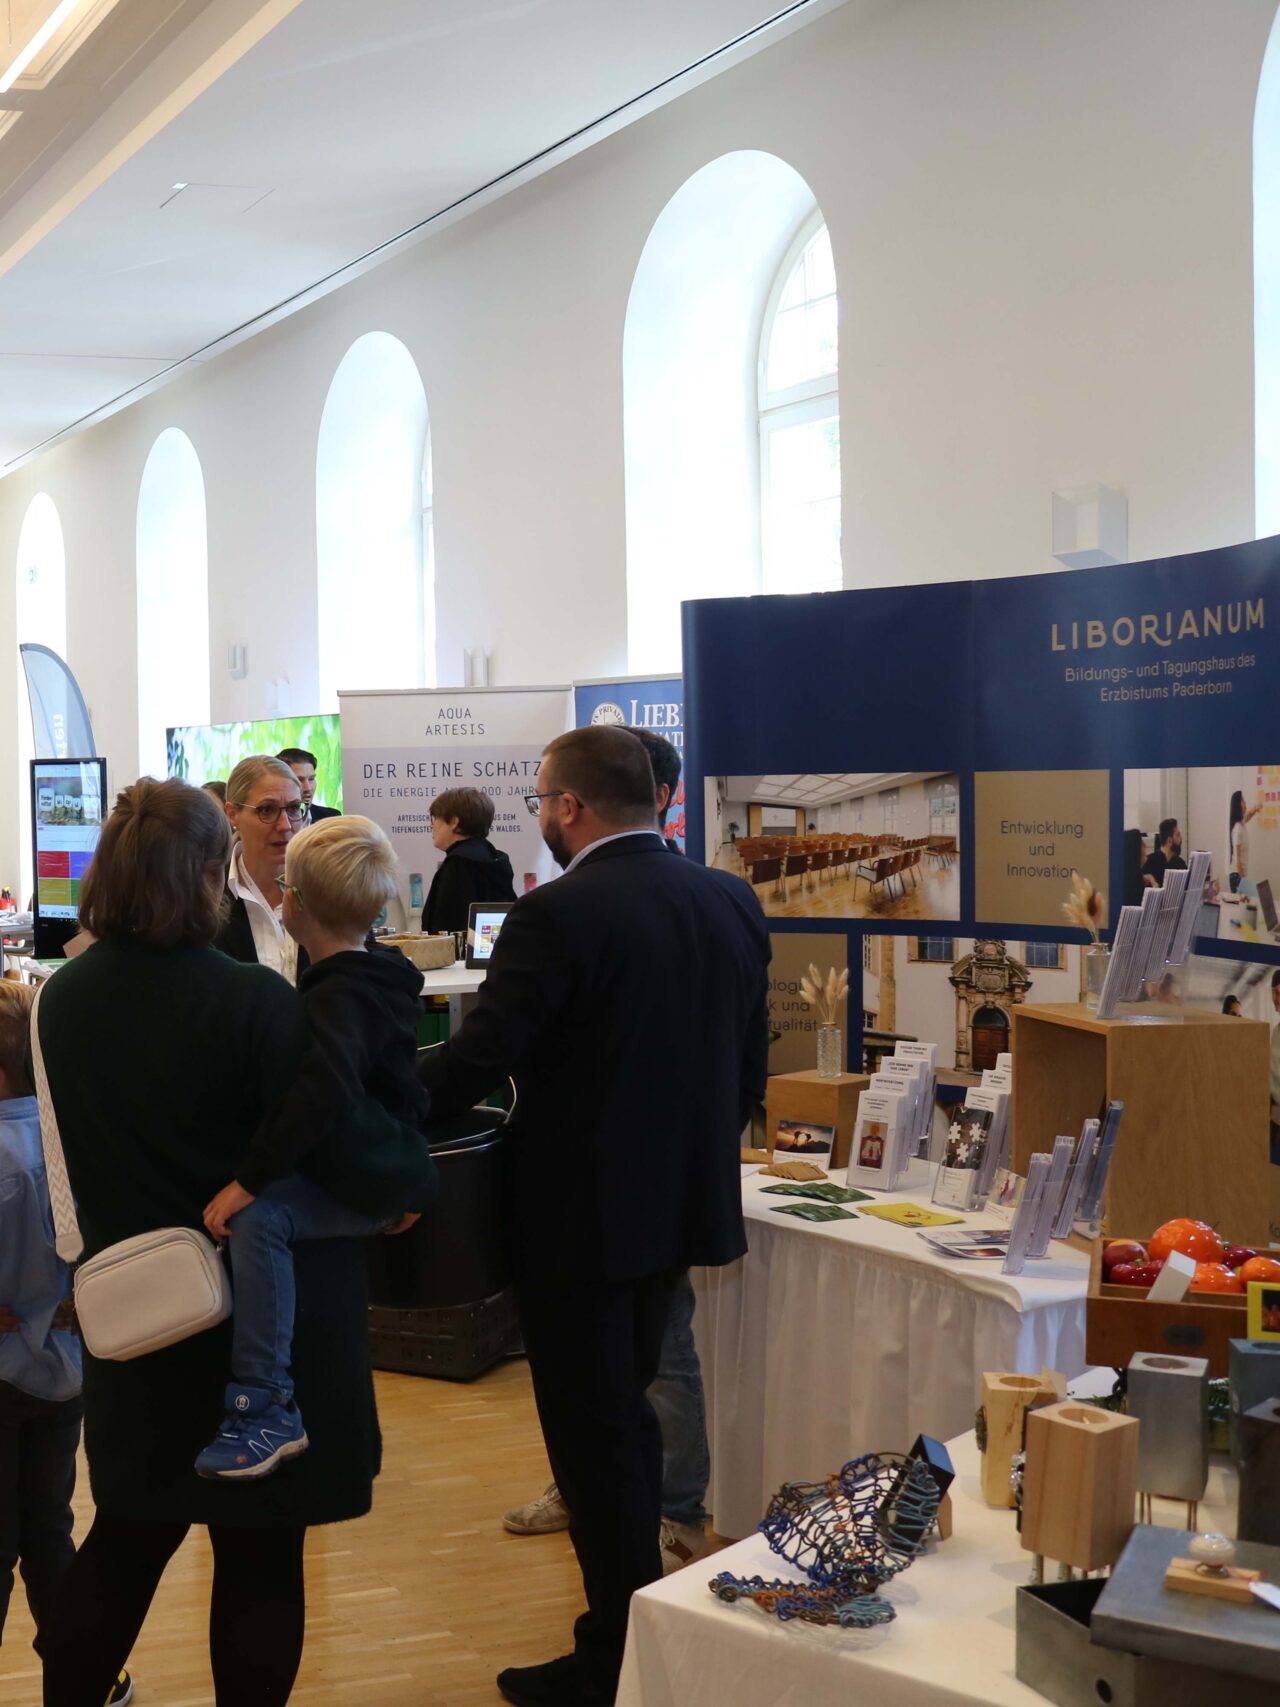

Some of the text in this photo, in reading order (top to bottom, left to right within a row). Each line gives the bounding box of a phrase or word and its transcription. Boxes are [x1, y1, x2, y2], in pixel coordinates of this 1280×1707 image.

[1051, 597, 1265, 652] LIBORIANUM
[1065, 652, 1256, 683] Bildungs- und Tagungshaus des
[1100, 680, 1233, 702] Erzbistums Paderborn
[438, 707, 472, 720] AQUA
[629, 699, 684, 728] LIEB
[425, 724, 485, 736] ARTESIS
[363, 761, 542, 779] DER REINE SCHATZ
[363, 788, 383, 798] DIE
[390, 786, 437, 798] ENERGIE
[507, 786, 535, 796] JAHR
[502, 813, 516, 821] DEM
[496, 824, 523, 832] WALDES.
[1000, 820, 1084, 838] Entwicklung
[1029, 842, 1055, 856] und
[1006, 863, 1078, 878] Innovation
[768, 1018, 818, 1032] tualität
